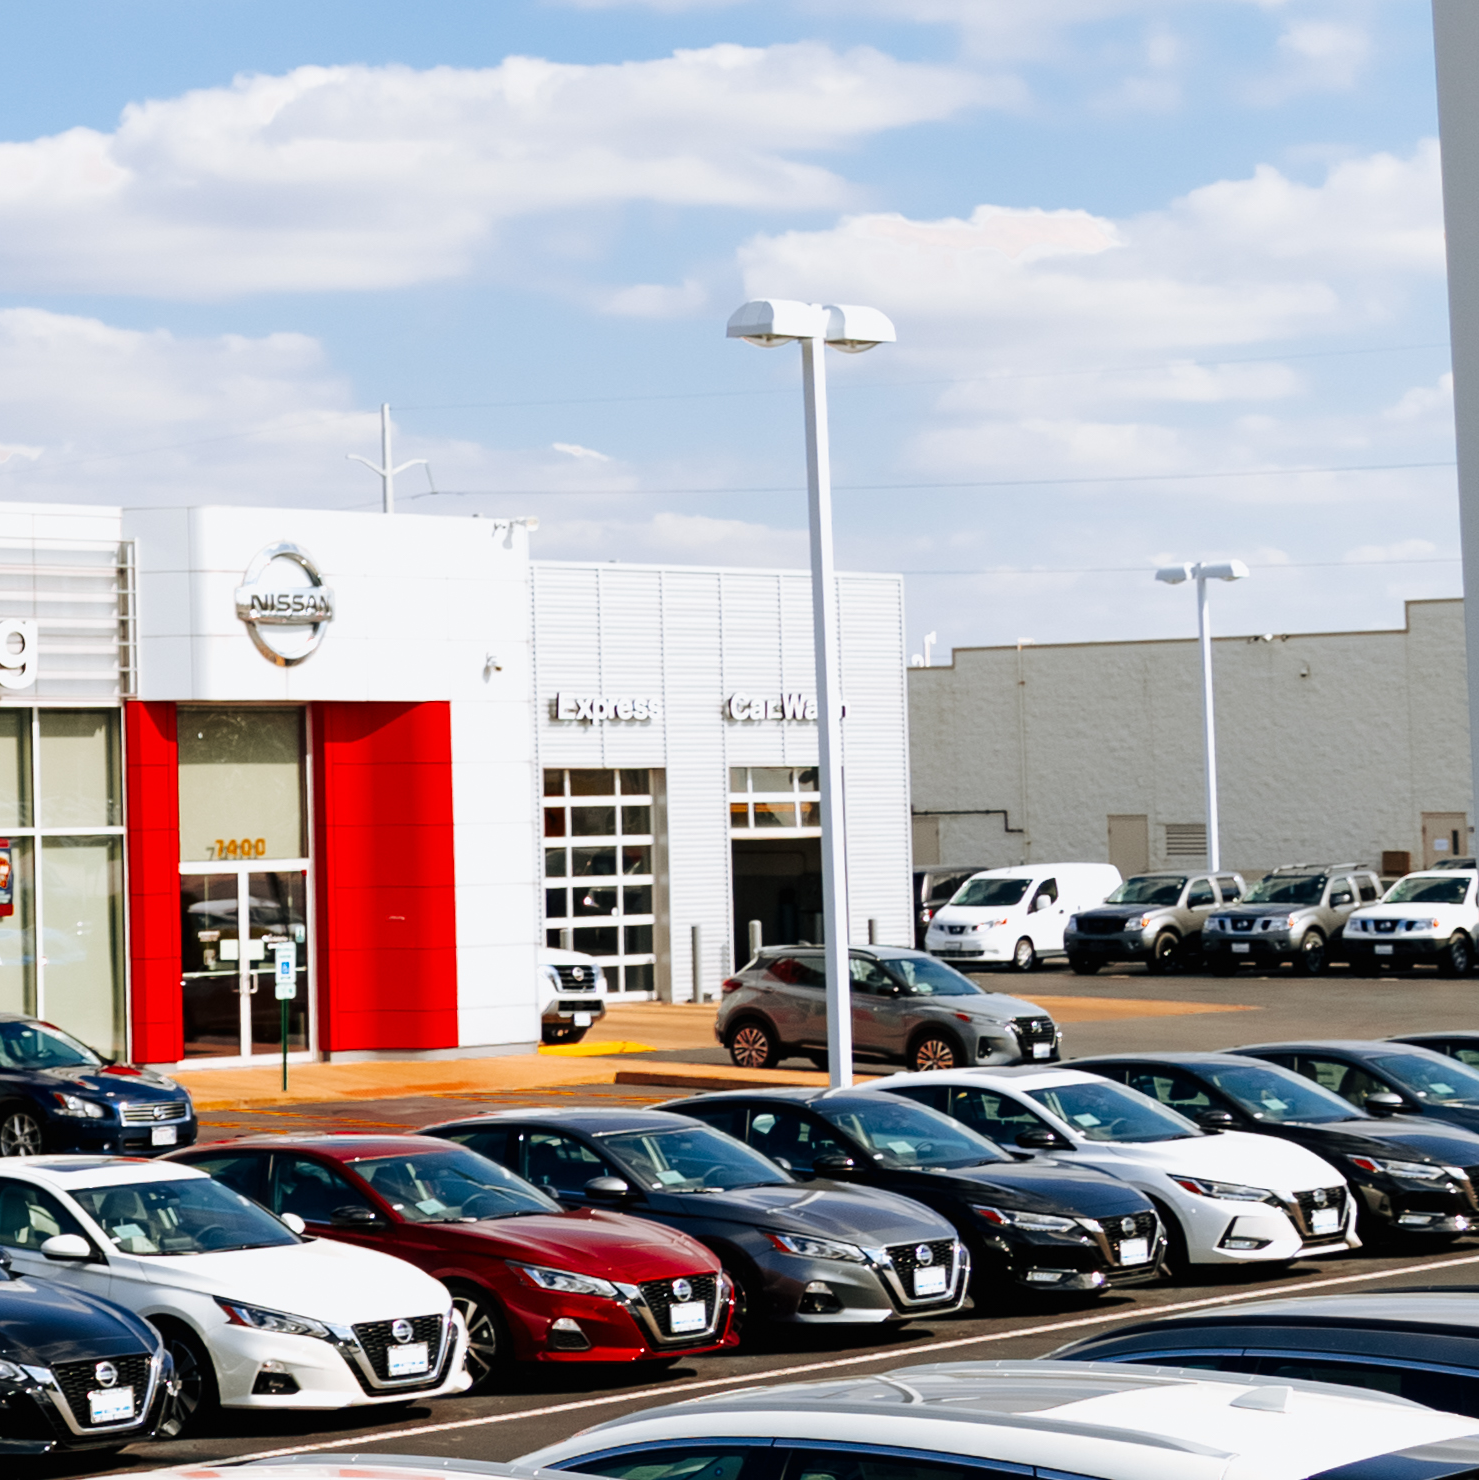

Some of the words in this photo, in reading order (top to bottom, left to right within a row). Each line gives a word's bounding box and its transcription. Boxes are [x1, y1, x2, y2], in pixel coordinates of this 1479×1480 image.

[251, 594, 330, 612] NISSAN
[558, 692, 663, 725] Express
[215, 838, 266, 858] 7400
